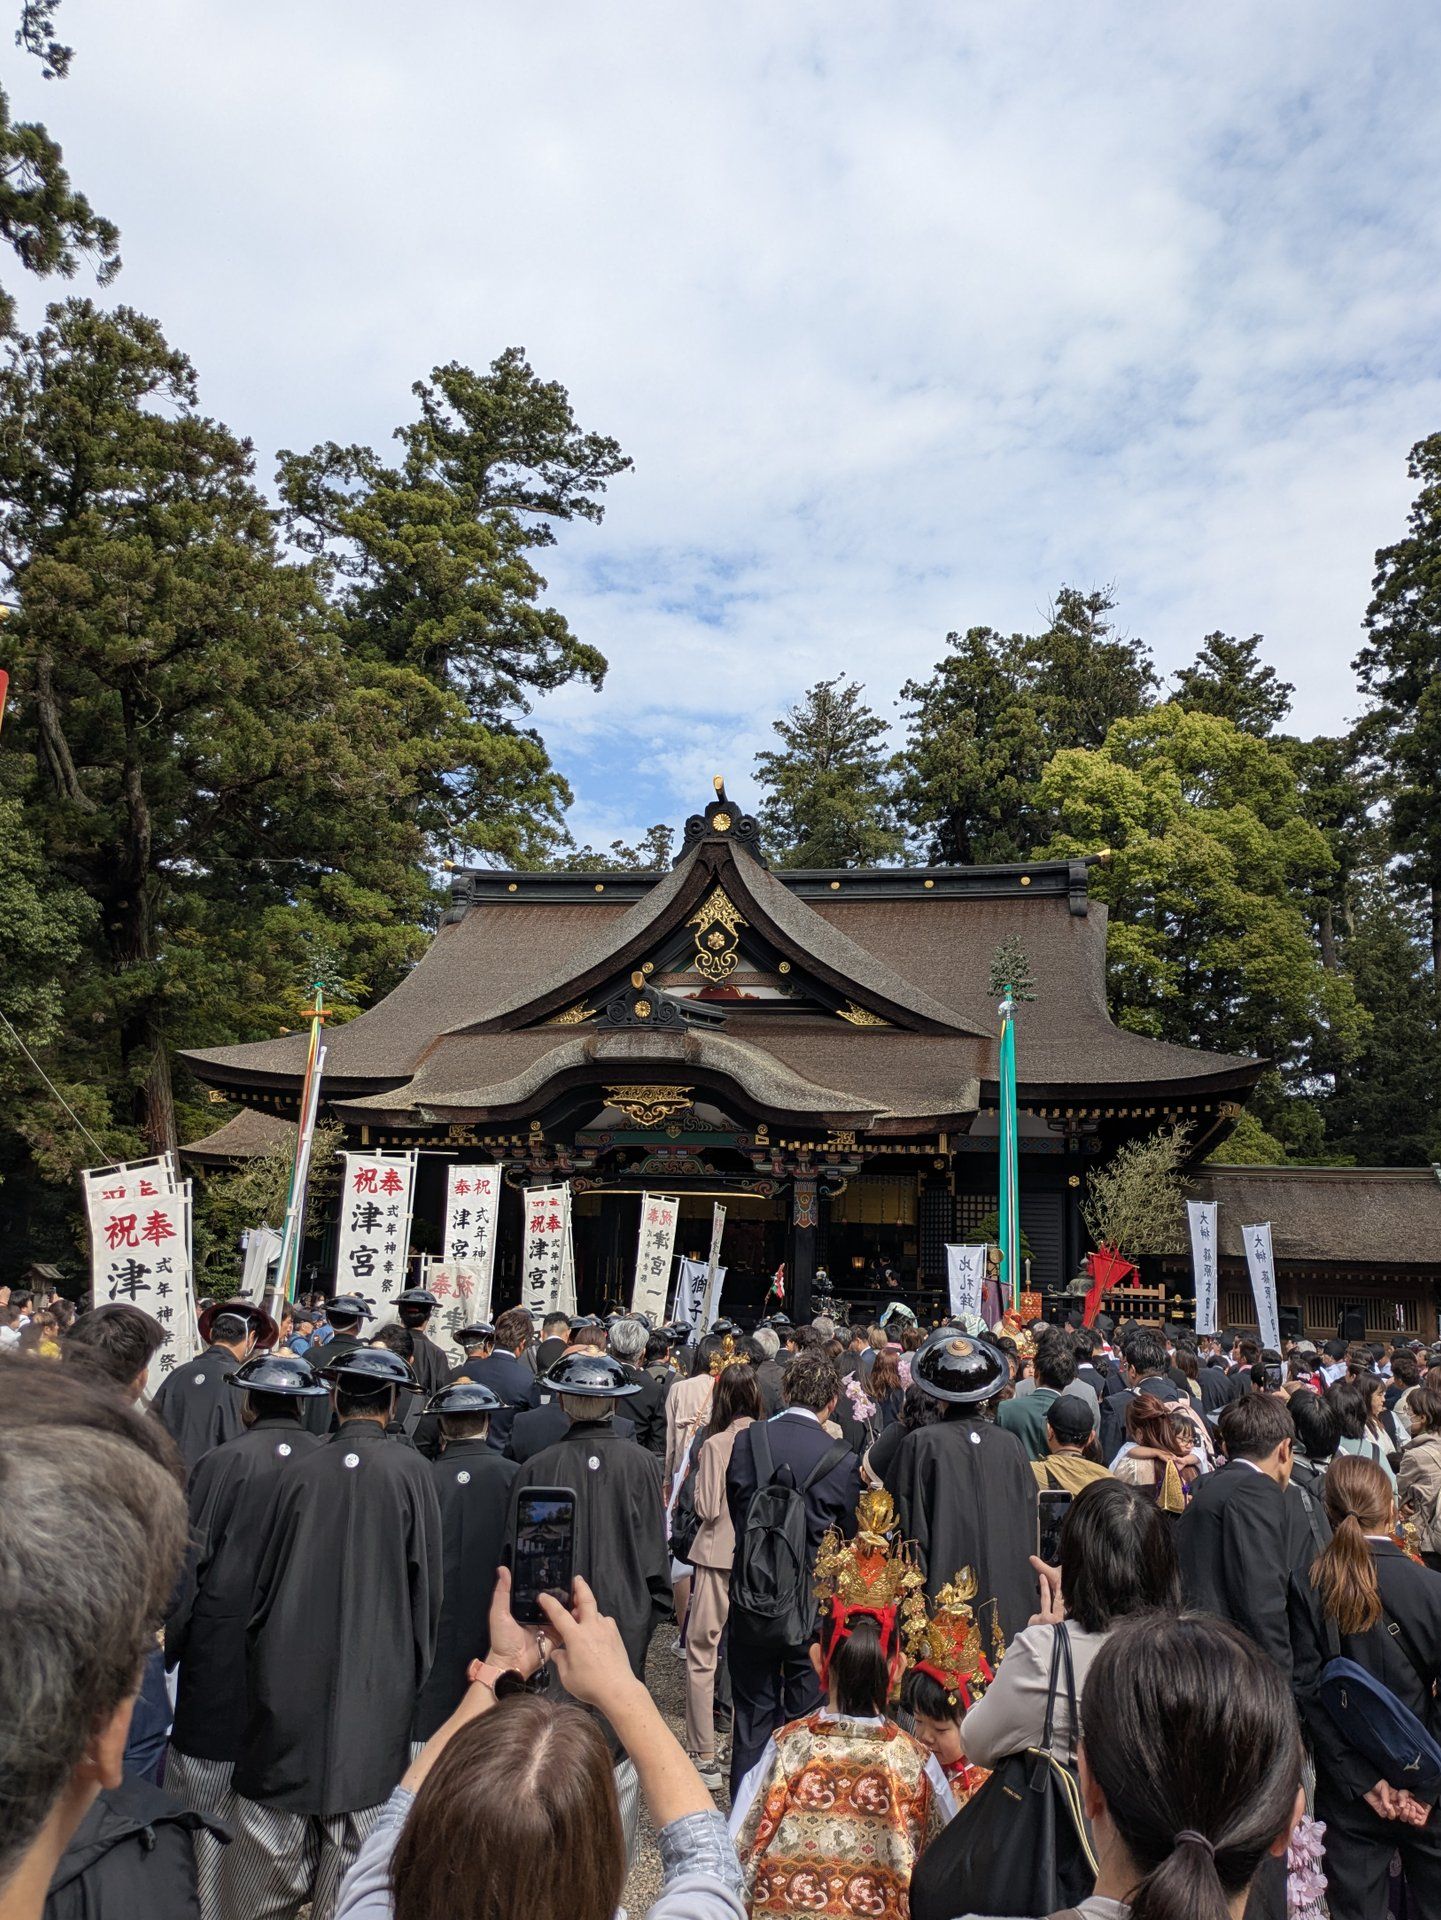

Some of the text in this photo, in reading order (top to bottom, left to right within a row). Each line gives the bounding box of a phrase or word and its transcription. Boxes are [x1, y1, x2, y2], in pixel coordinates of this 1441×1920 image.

[349, 1201, 384, 1305] 津宮
[381, 1204, 399, 1292] 式年神幸祭
[528, 1238, 550, 1341] 津宮三
